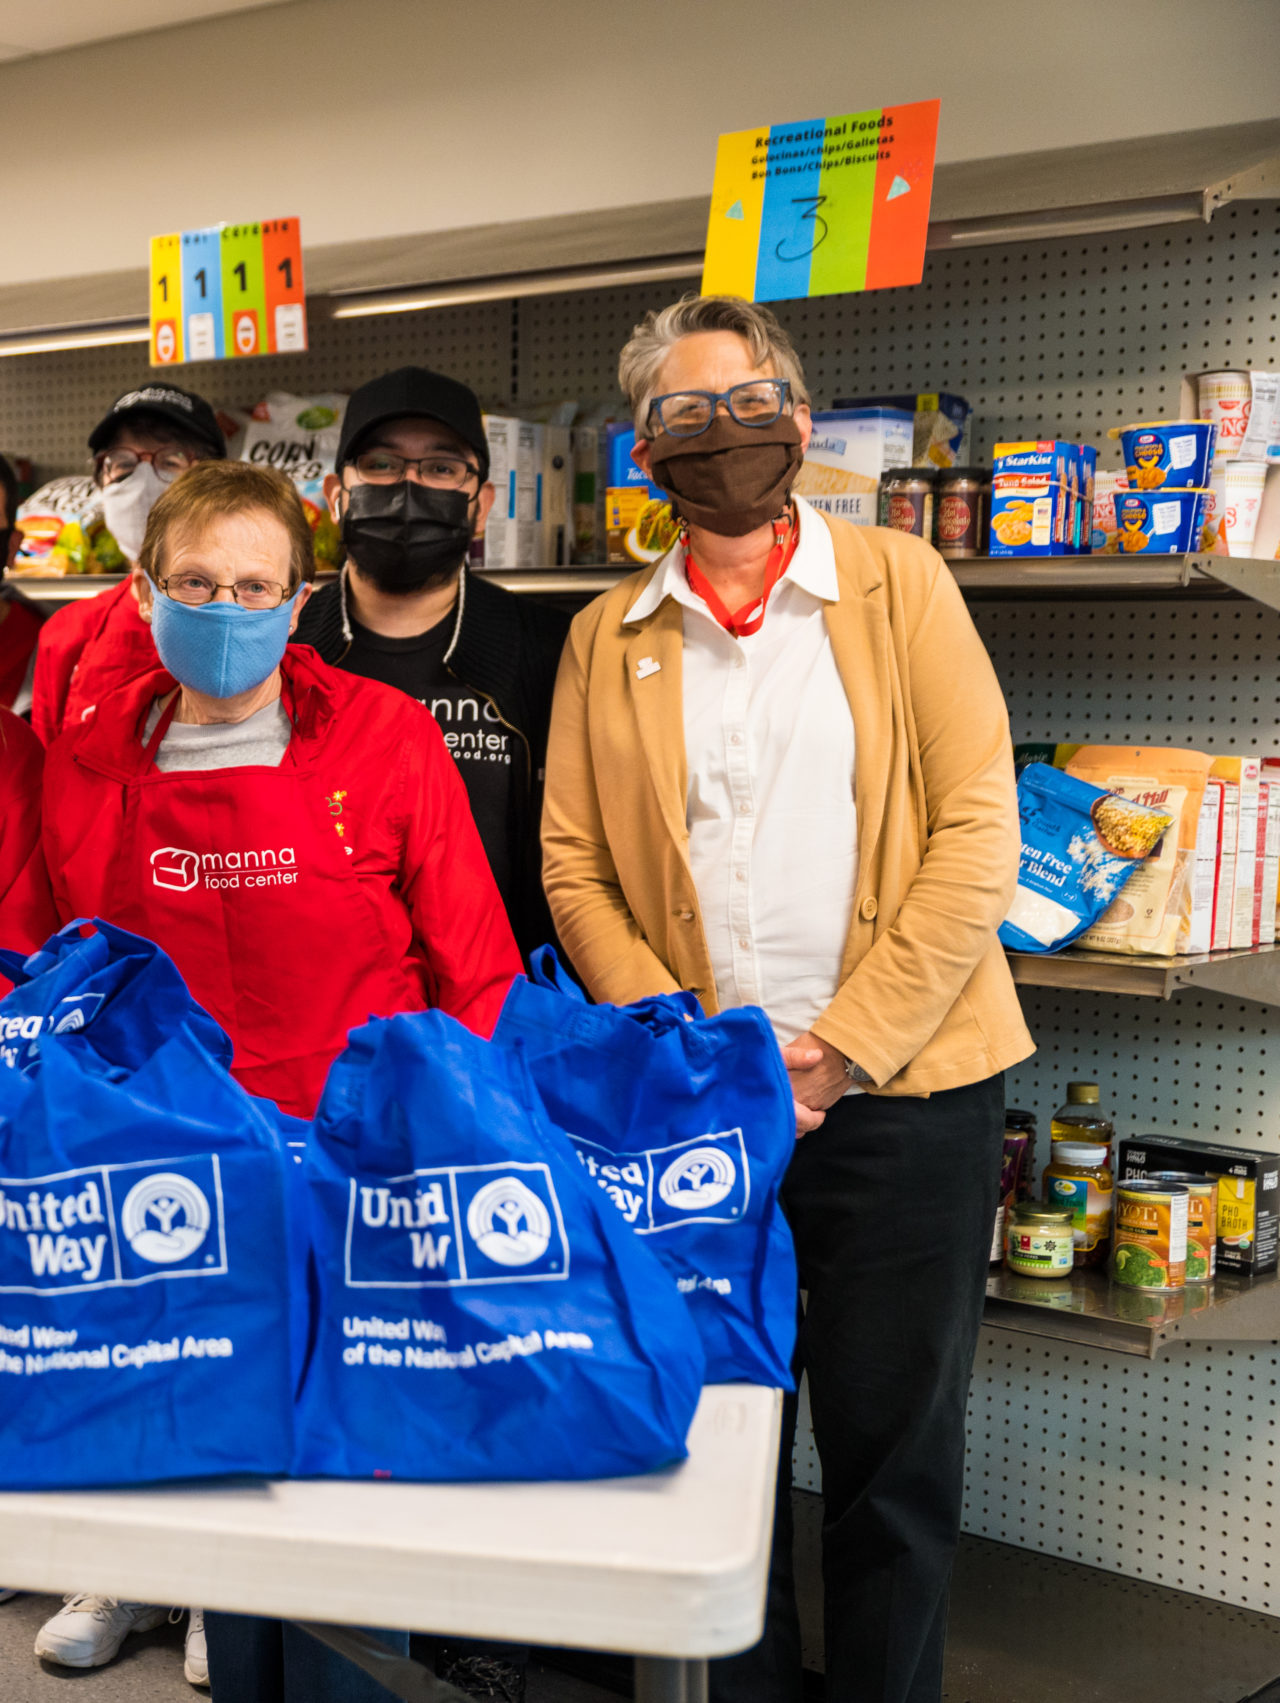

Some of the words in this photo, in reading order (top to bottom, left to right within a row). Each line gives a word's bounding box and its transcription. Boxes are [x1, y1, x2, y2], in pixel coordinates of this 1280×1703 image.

[755, 121, 847, 148] Recreational
[851, 115, 894, 133] Foods
[775, 195, 828, 263] 3
[158, 275, 168, 302] 1
[195, 268, 207, 299] 1
[234, 261, 247, 292] 1
[278, 257, 293, 289] 1
[1006, 453, 1052, 467] StarKist
[835, 498, 862, 514] FREE
[416, 698, 501, 723] nna
[443, 728, 509, 751] enter
[448, 749, 512, 765] ood.org
[201, 847, 296, 870] manna
[1041, 852, 1072, 874] Free
[204, 874, 240, 889] food
[244, 870, 299, 888] center
[1027, 860, 1067, 888] Blend
[575, 1150, 645, 1187] ited
[598, 1179, 644, 1223] ay
[1222, 1204, 1240, 1217] PHO
[1221, 1216, 1249, 1231] BROTH
[26, 1233, 108, 1282] Way
[31, 1325, 79, 1349] Way
[342, 1315, 411, 1341] United
[24, 1344, 110, 1377] National
[111, 1336, 180, 1370] Capital
[181, 1335, 233, 1359] Area
[342, 1341, 366, 1367] of
[367, 1342, 403, 1368] the
